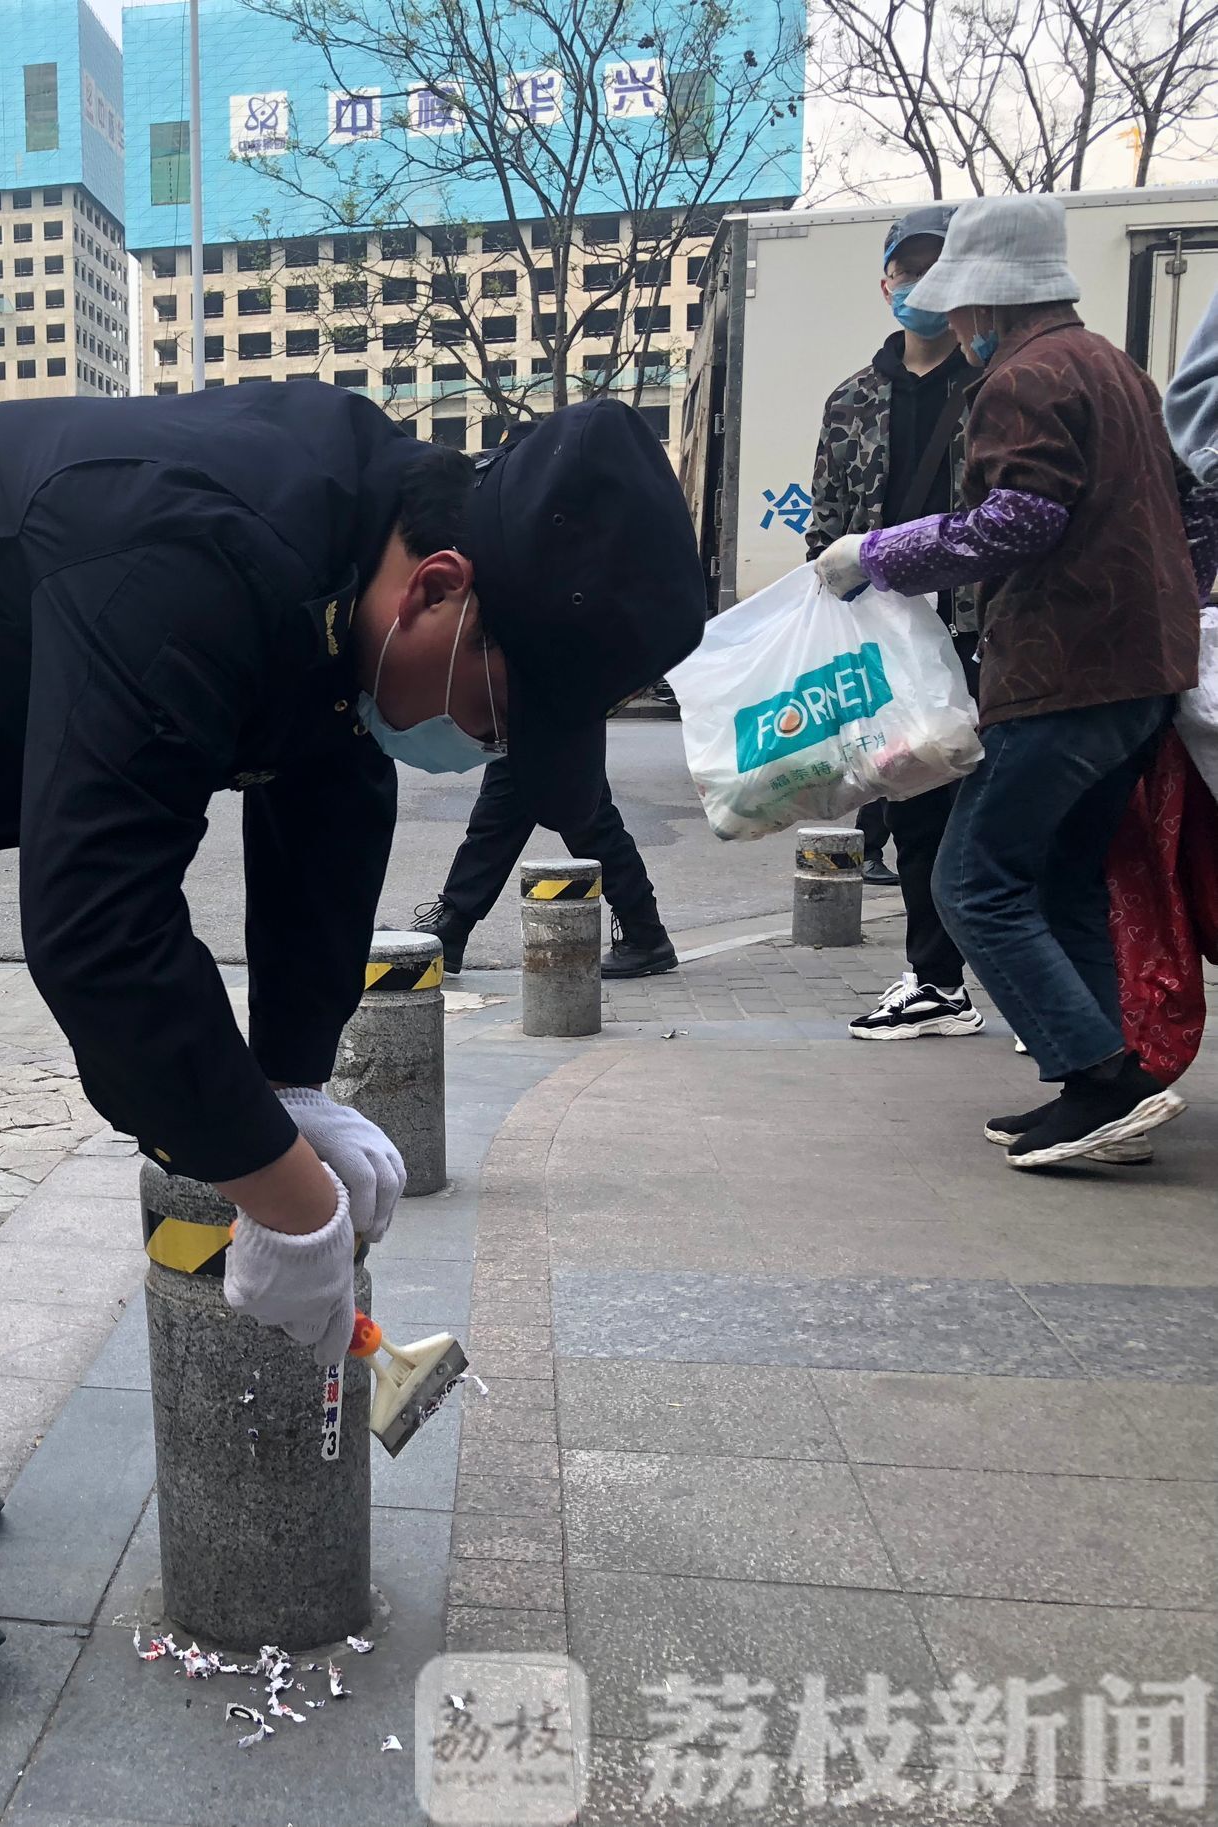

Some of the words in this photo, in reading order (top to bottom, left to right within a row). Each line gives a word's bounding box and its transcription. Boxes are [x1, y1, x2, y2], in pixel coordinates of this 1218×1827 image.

[335, 66, 655, 136] 中核华兴
[760, 483, 812, 534] 冷
